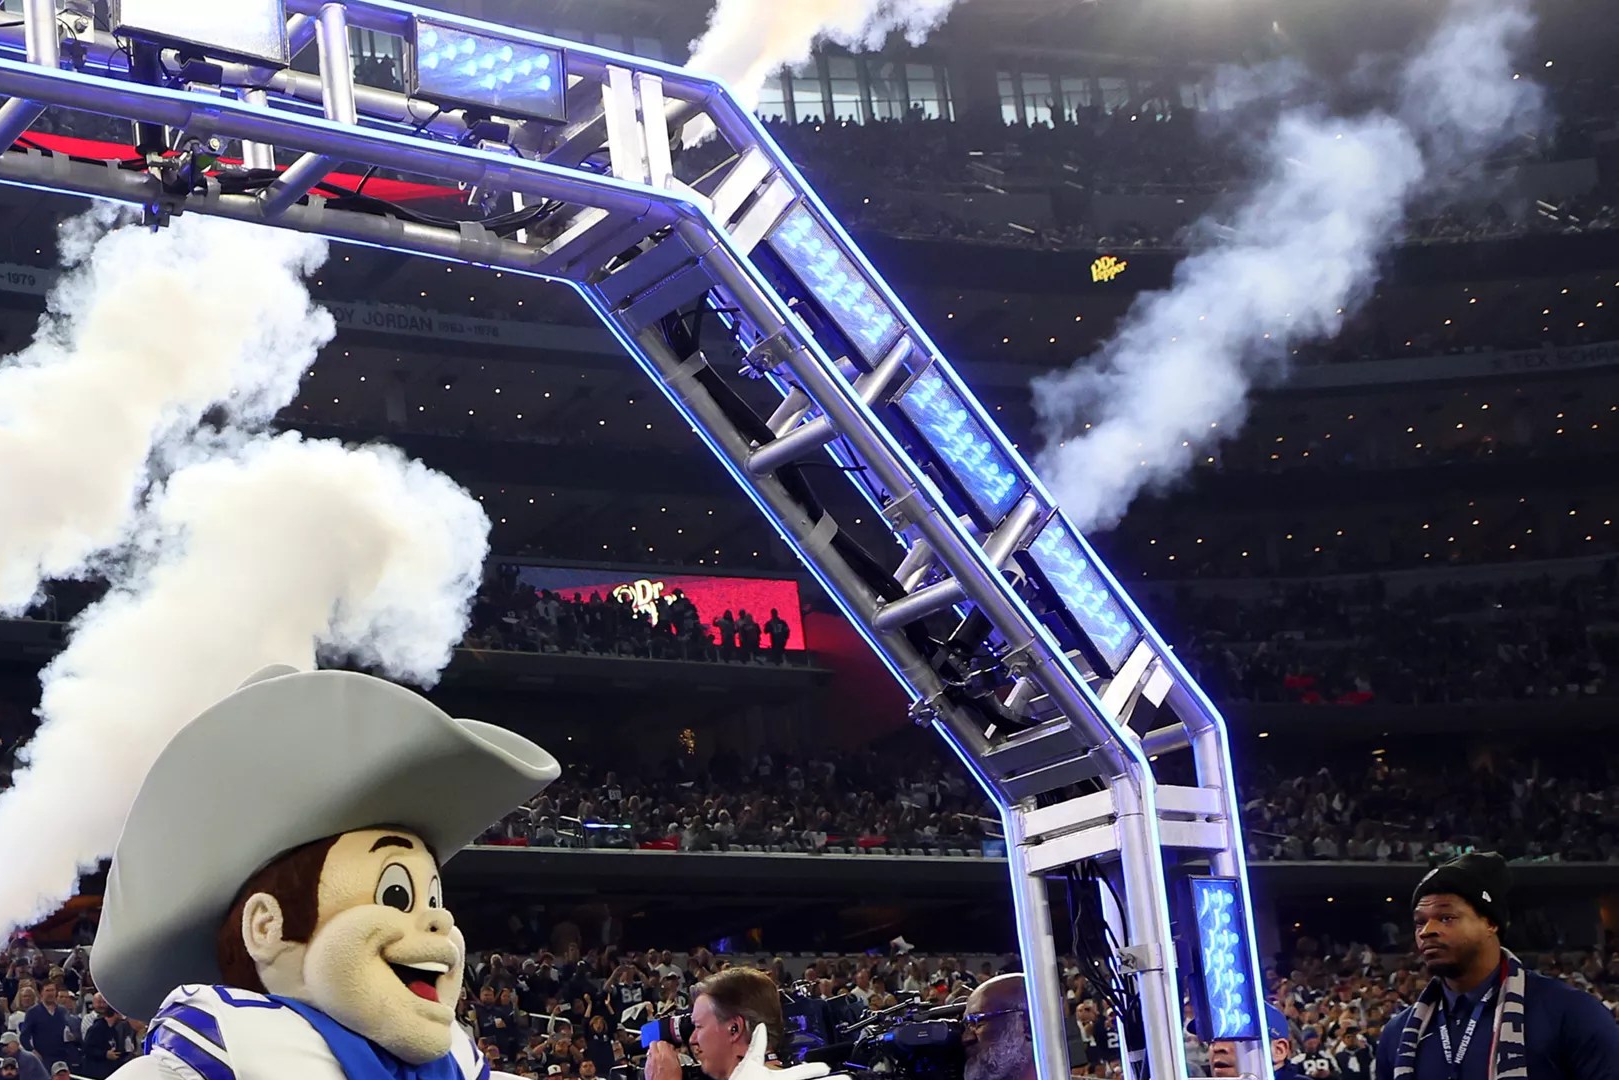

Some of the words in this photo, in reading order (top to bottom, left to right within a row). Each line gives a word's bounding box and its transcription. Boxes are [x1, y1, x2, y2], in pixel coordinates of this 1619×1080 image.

[362, 311, 433, 332] JORDAN
[1438, 1024, 1451, 1050] STADIUM
[1453, 1034, 1471, 1064] STADIUM
